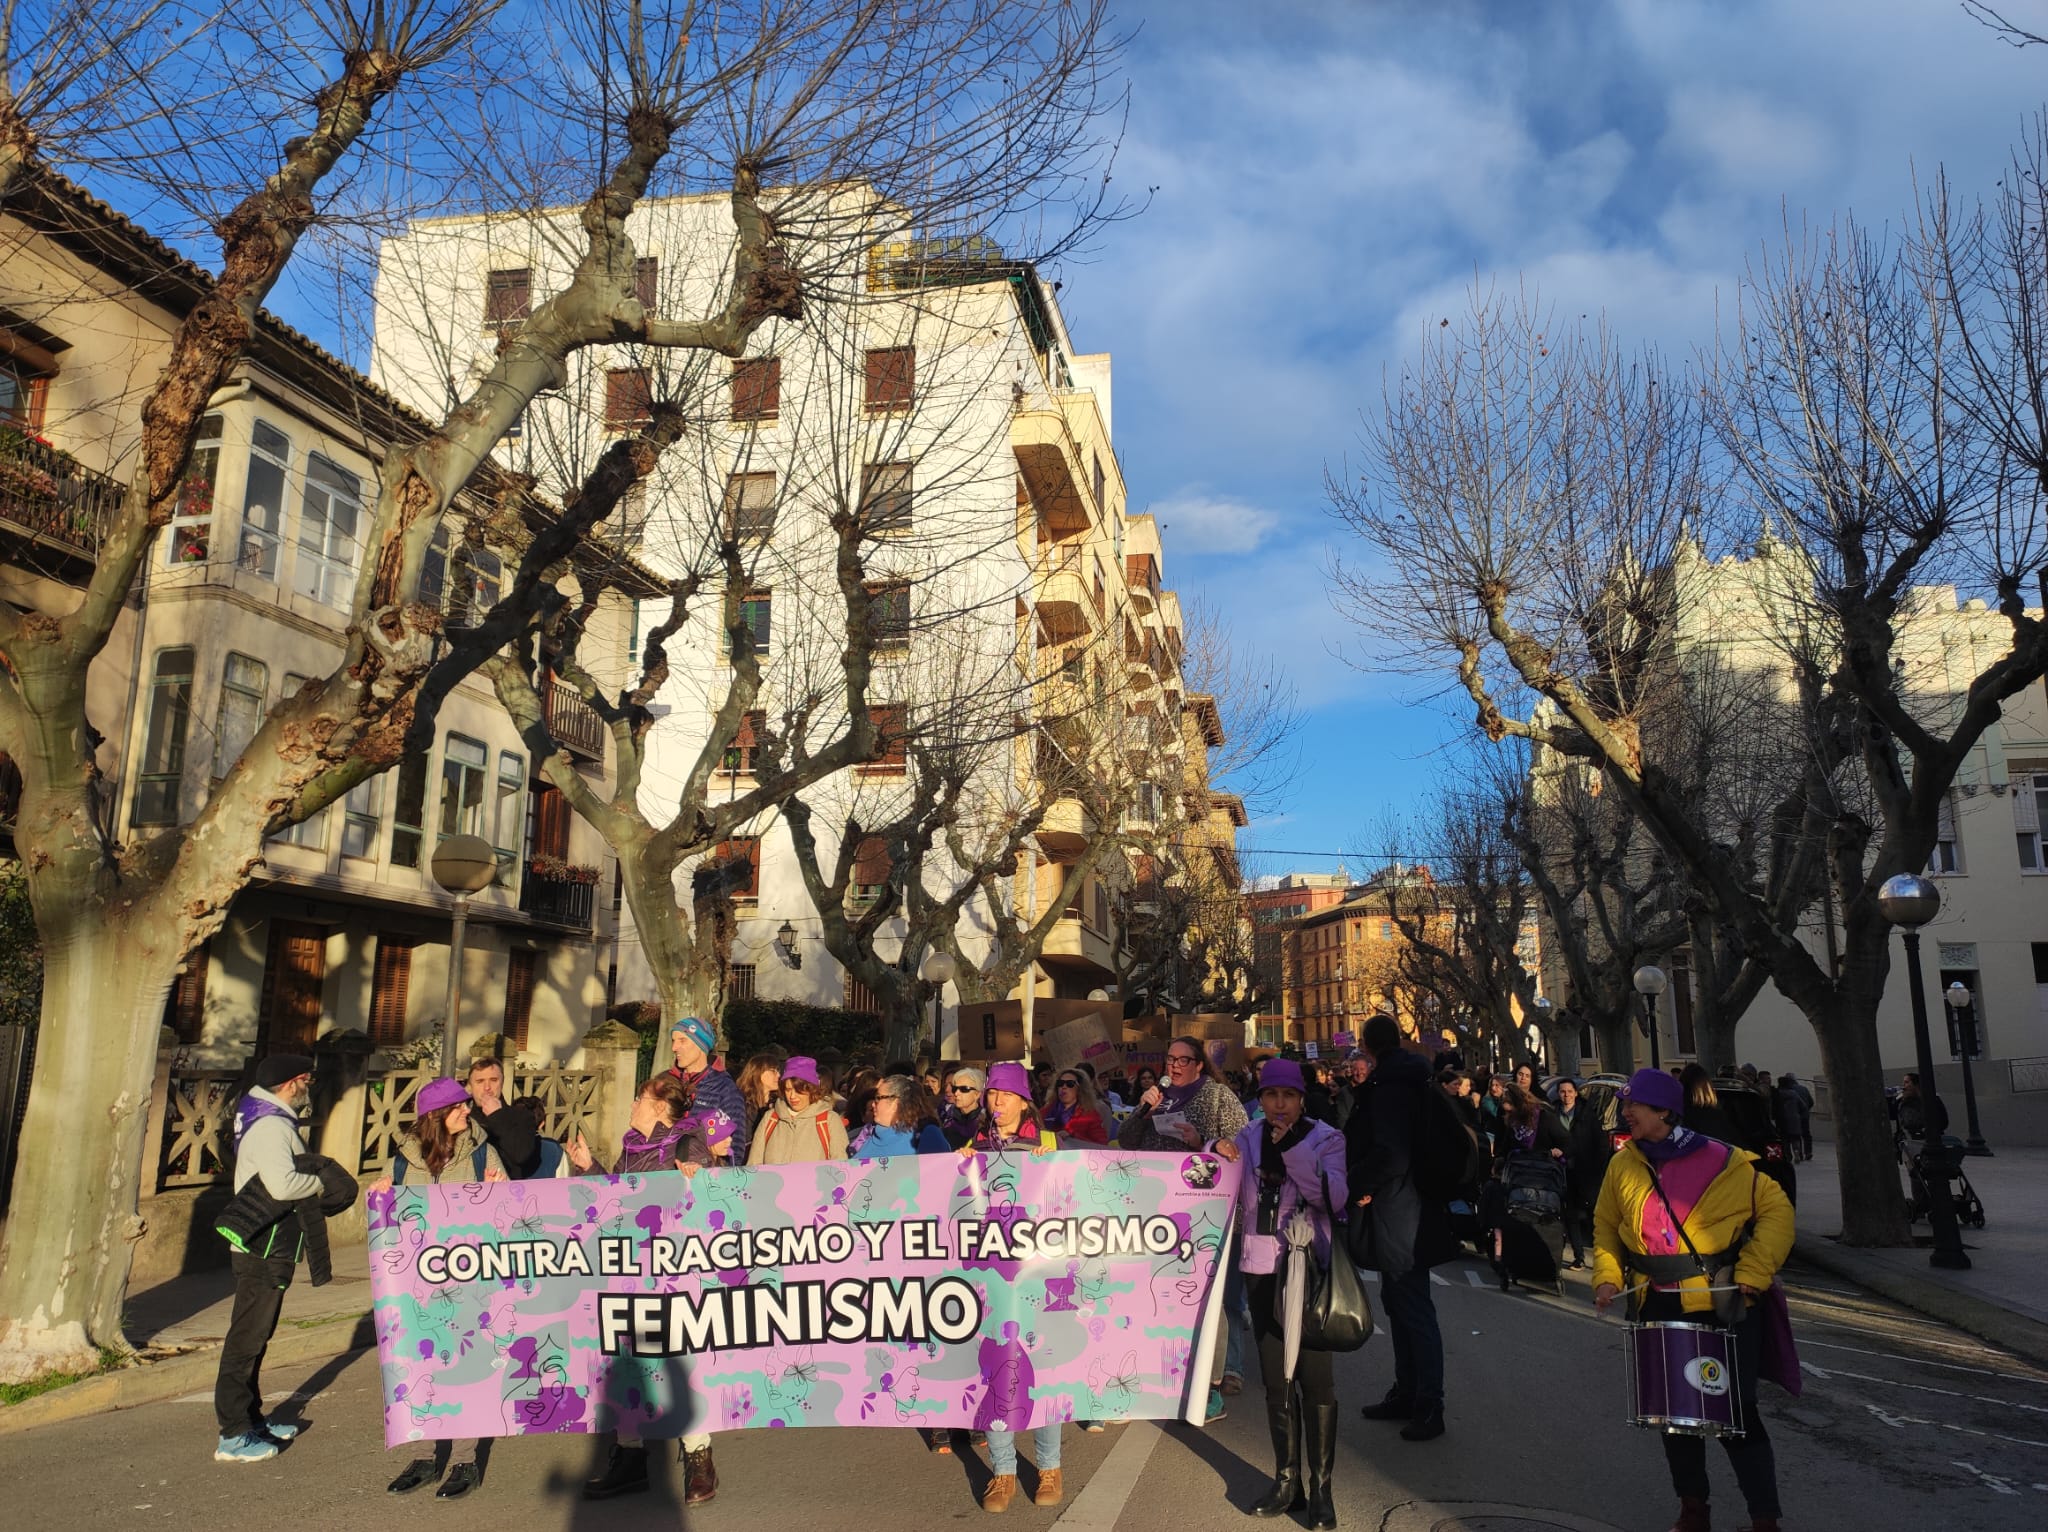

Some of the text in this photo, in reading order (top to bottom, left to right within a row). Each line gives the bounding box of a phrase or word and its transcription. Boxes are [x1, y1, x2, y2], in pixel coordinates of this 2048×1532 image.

[418, 1215, 1193, 1283] CONTRA EL RACISMO Y EL FASCISMO,
[598, 1276, 982, 1359] FEMINISMO
